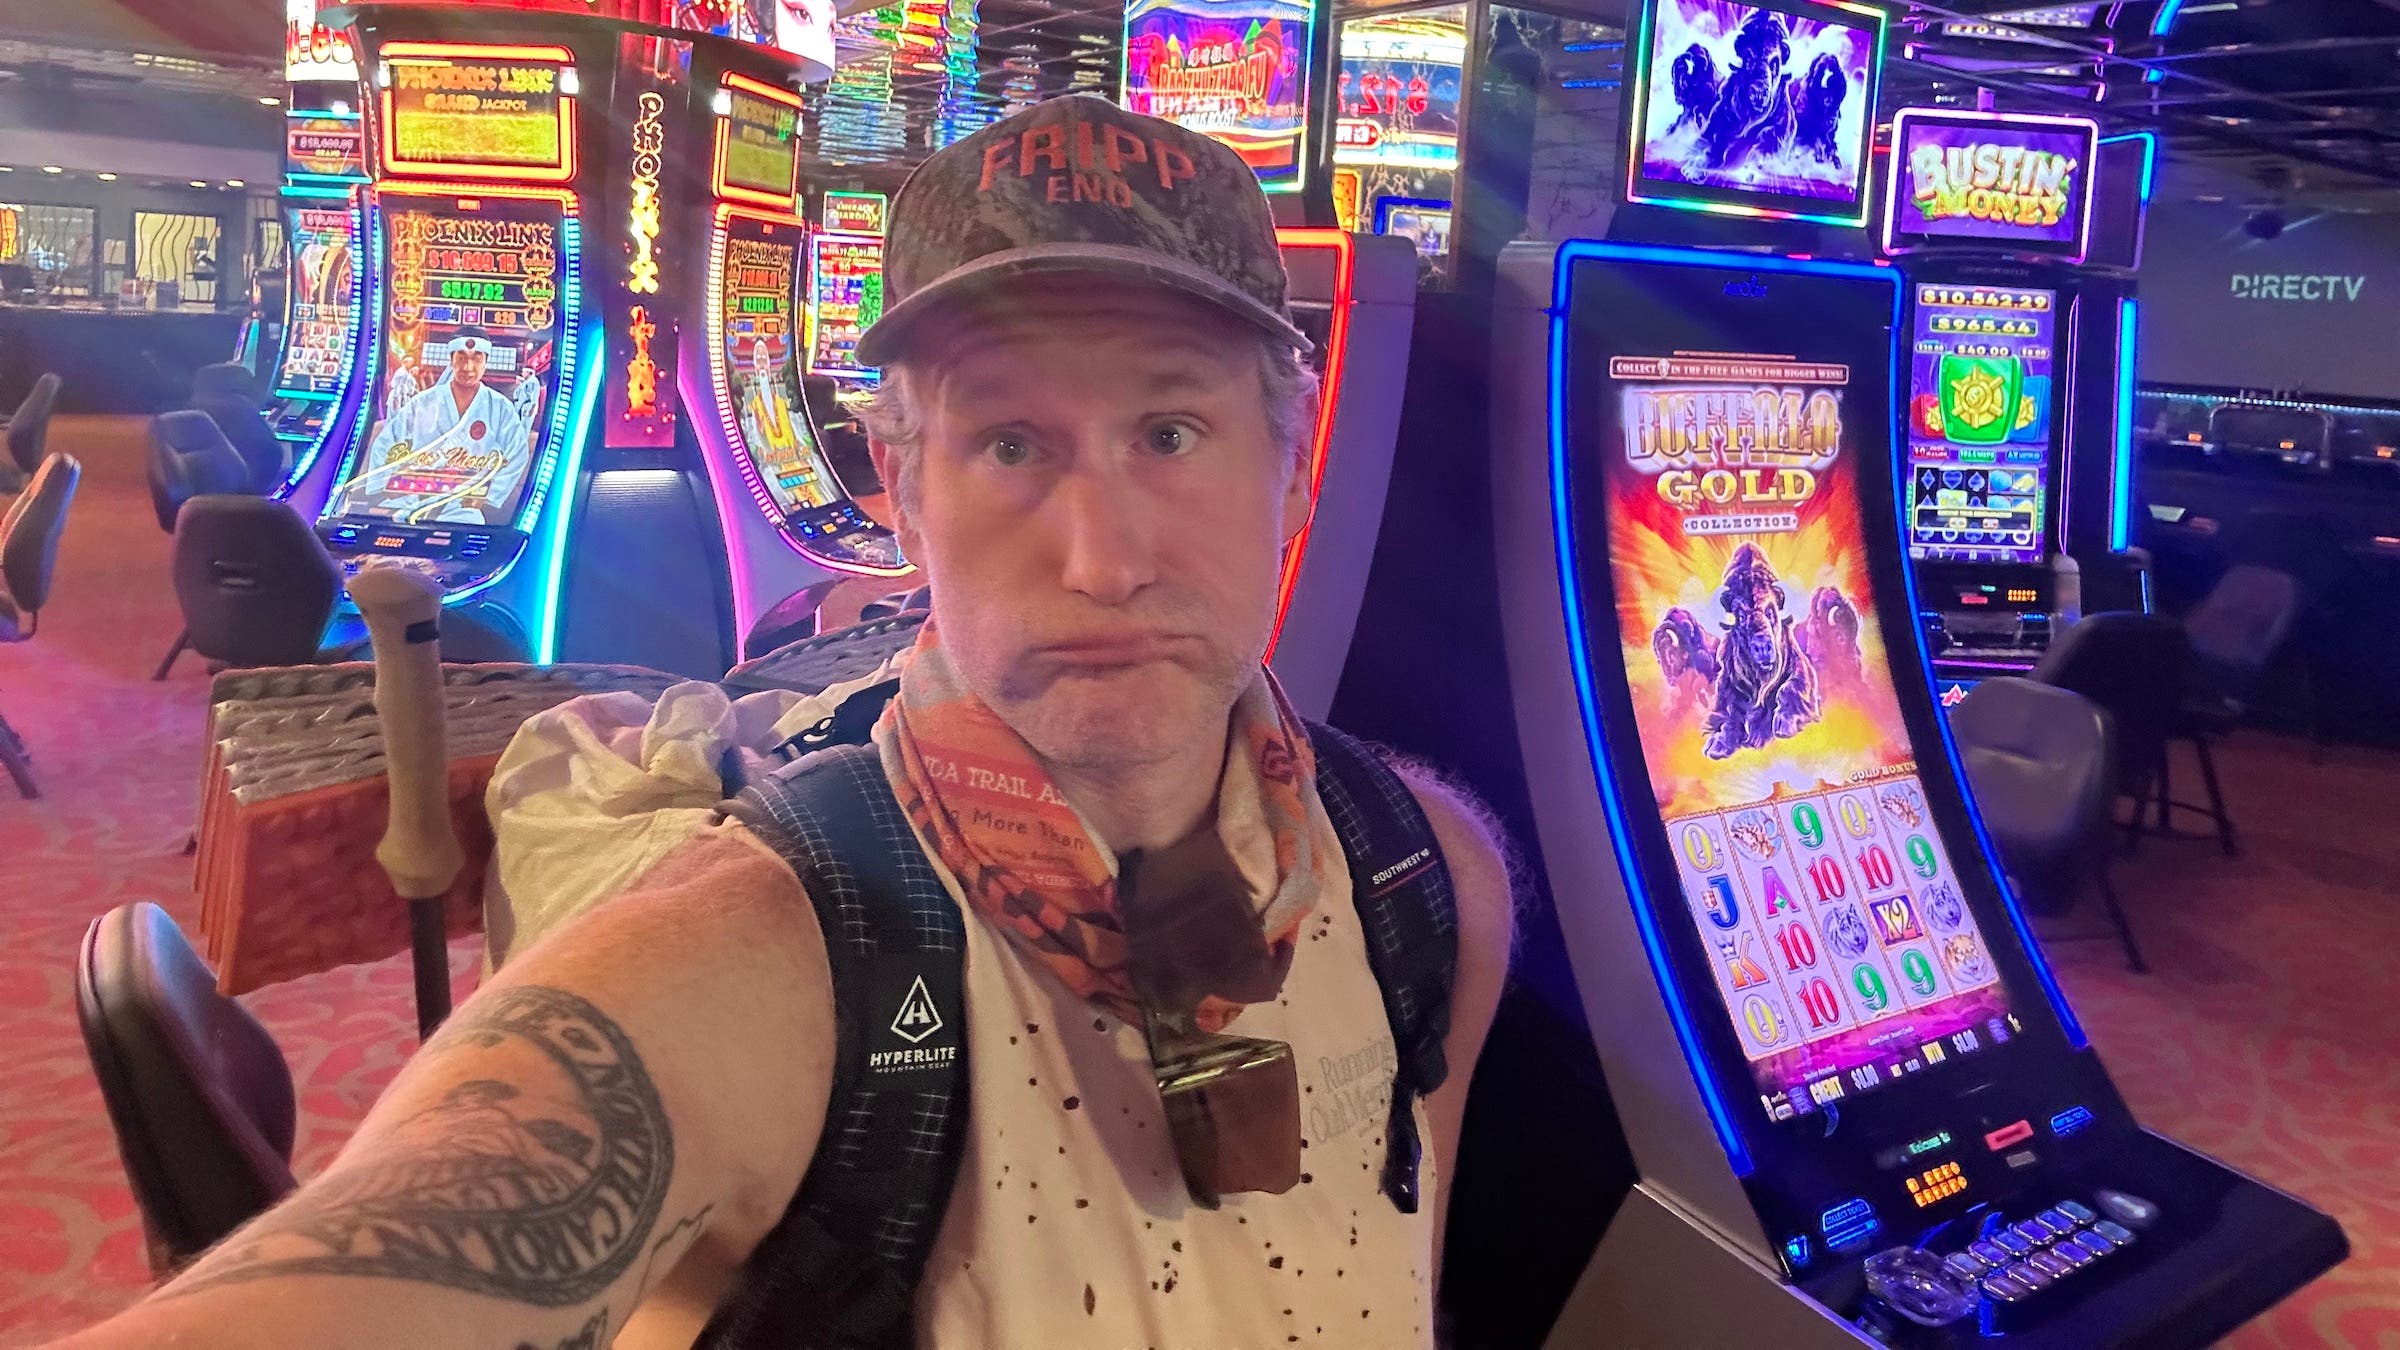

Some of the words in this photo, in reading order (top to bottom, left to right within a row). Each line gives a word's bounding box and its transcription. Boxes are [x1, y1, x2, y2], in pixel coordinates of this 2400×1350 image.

[481, 98, 527, 111] JACKPOT
[977, 121, 1196, 193] FRIPP
[1909, 142, 2077, 199] BUSTIN'
[629, 91, 664, 294] PHOENIX
[1047, 174, 1132, 208] END
[1932, 188, 2068, 228] MONEY
[391, 214, 495, 244] PHOENIX
[496, 221, 553, 247] LINK
[2230, 274, 2365, 301] DIRECTV
[1616, 362, 1656, 374] COLLECT
[1670, 365, 1682, 376] IN
[1684, 366, 1701, 376] THE
[1703, 365, 1729, 377] FREE
[1731, 365, 1762, 377] GAMES
[1765, 367, 1782, 378] FOR
[1784, 368, 1816, 379] BIGGER
[1624, 388, 1841, 468] BUFFALO
[1657, 469, 1816, 506] GOLD
[1690, 515, 1793, 531] COLLECTION
[968, 767, 1032, 799] TRAIL
[1849, 766, 1880, 783] GOLD
[1882, 760, 1918, 777] BONUS
[972, 808, 1028, 837] More
[1037, 819, 1086, 852] Than
[1791, 801, 1825, 850] 9
[1839, 794, 1876, 841] Q
[1372, 851, 1422, 885] SOUTHWEST
[1681, 822, 1724, 873] Q
[1857, 844, 1895, 893] 10
[1904, 833, 1938, 880] 9
[1703, 873, 1741, 930] J
[1761, 866, 1801, 919] A
[1806, 854, 1848, 904] 10
[1722, 930, 1770, 991] K
[1775, 921, 1818, 974] 10
[1853, 962, 1889, 1013] 9
[1900, 948, 1937, 997] 9
[1742, 993, 1787, 1048] Q
[1797, 976, 1841, 1031] 10
[869, 1046, 956, 1067] HYPERLITE
